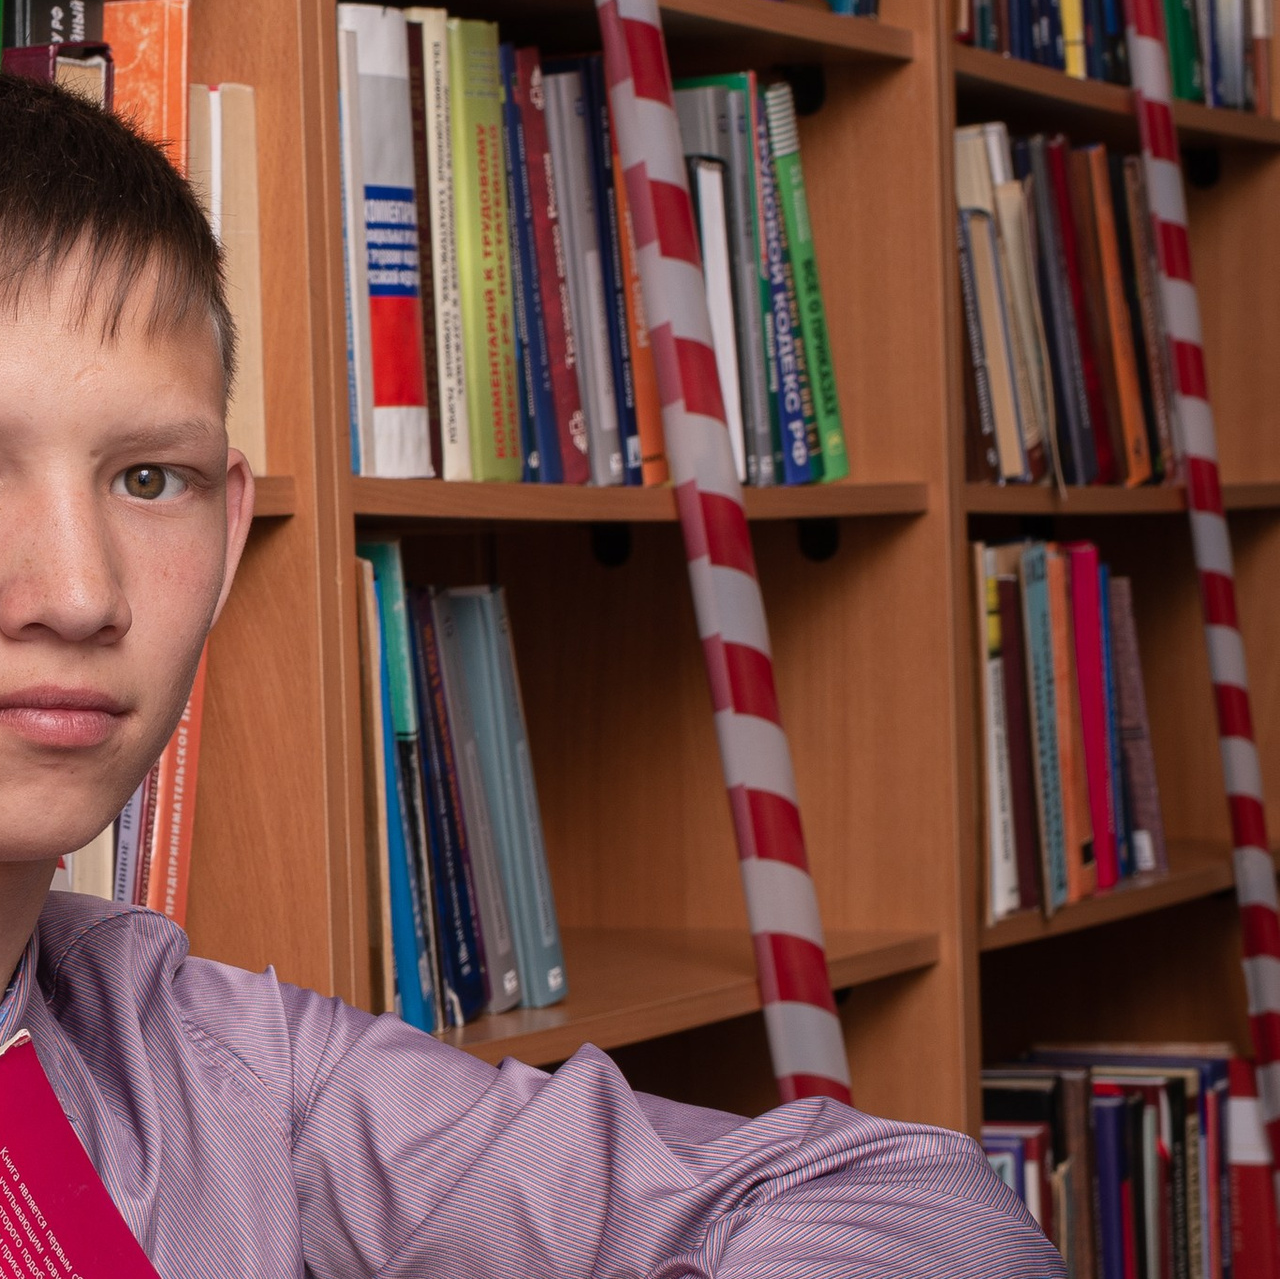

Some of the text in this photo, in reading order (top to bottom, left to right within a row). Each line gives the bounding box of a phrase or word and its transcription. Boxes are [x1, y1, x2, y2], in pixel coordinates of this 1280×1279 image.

[476, 123, 508, 459] КОММЕНТАРИЙ К ТРУДОВОМУ
[753, 123, 807, 465] ТРУДОВОЙ КОДЕКС РФ
[164, 726, 188, 916] ПРЕДПРИНИМАТЕЛЬСКОЕ
[0, 1146, 20, 1182] Книга
[18, 1182, 48, 1230] является
[45, 1229, 73, 1273] первым
